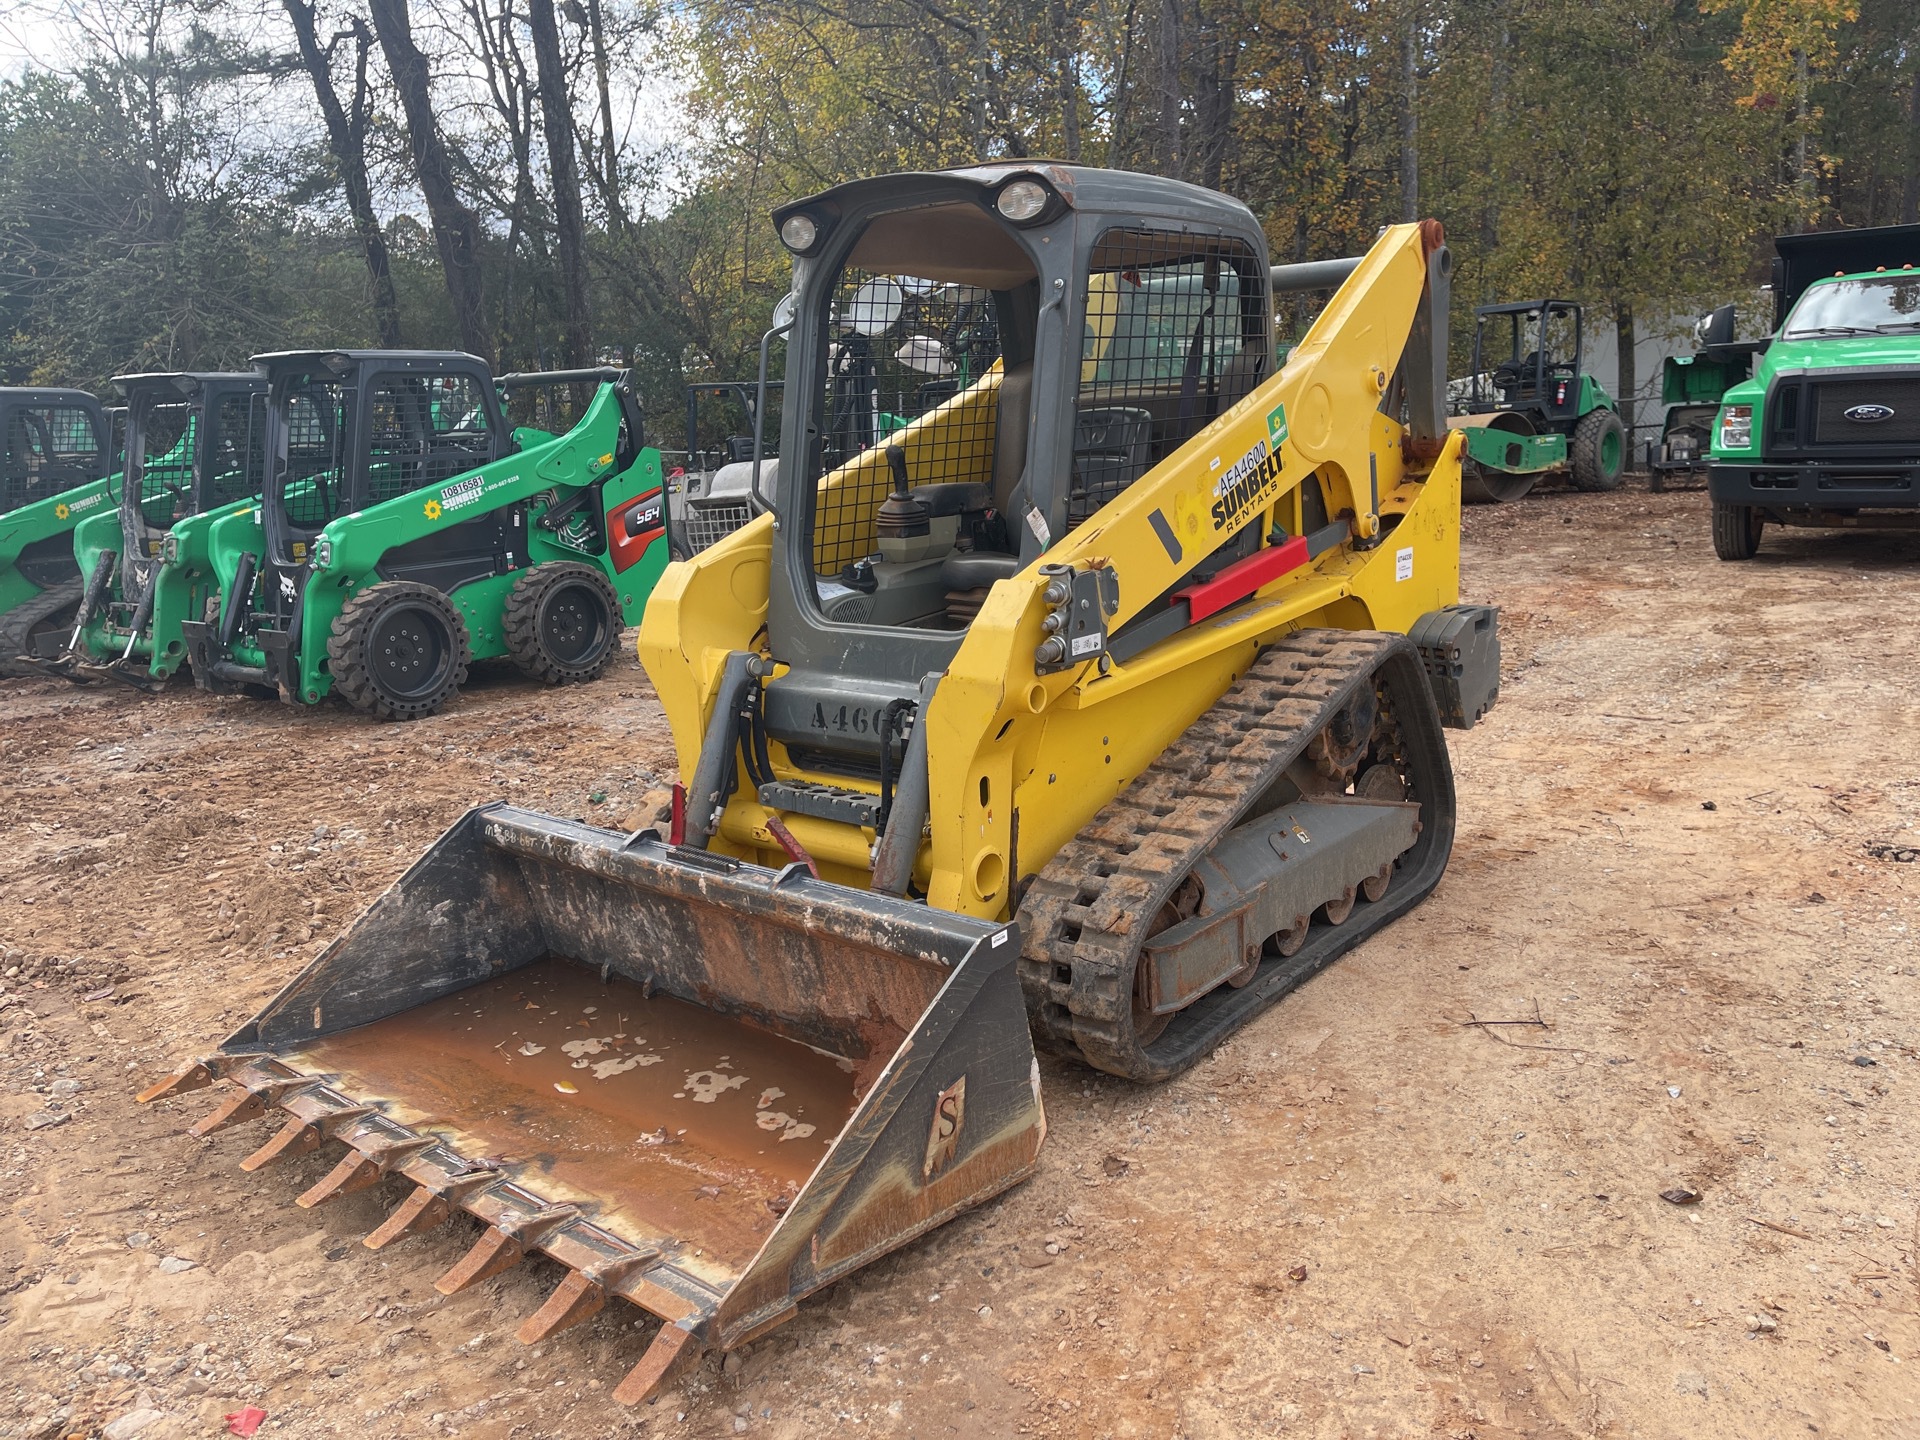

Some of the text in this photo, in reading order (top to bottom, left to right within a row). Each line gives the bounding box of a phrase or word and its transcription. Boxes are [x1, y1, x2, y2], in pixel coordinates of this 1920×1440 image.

[1854, 407, 1883, 419] Ford
[1220, 440, 1267, 497] AEA4600
[441, 487, 484, 510] SUNBELT
[442, 476, 484, 498] 10816581
[1211, 445, 1284, 531] SUNBELT
[636, 506, 660, 525] S64
[1226, 480, 1278, 534] RENTALS
